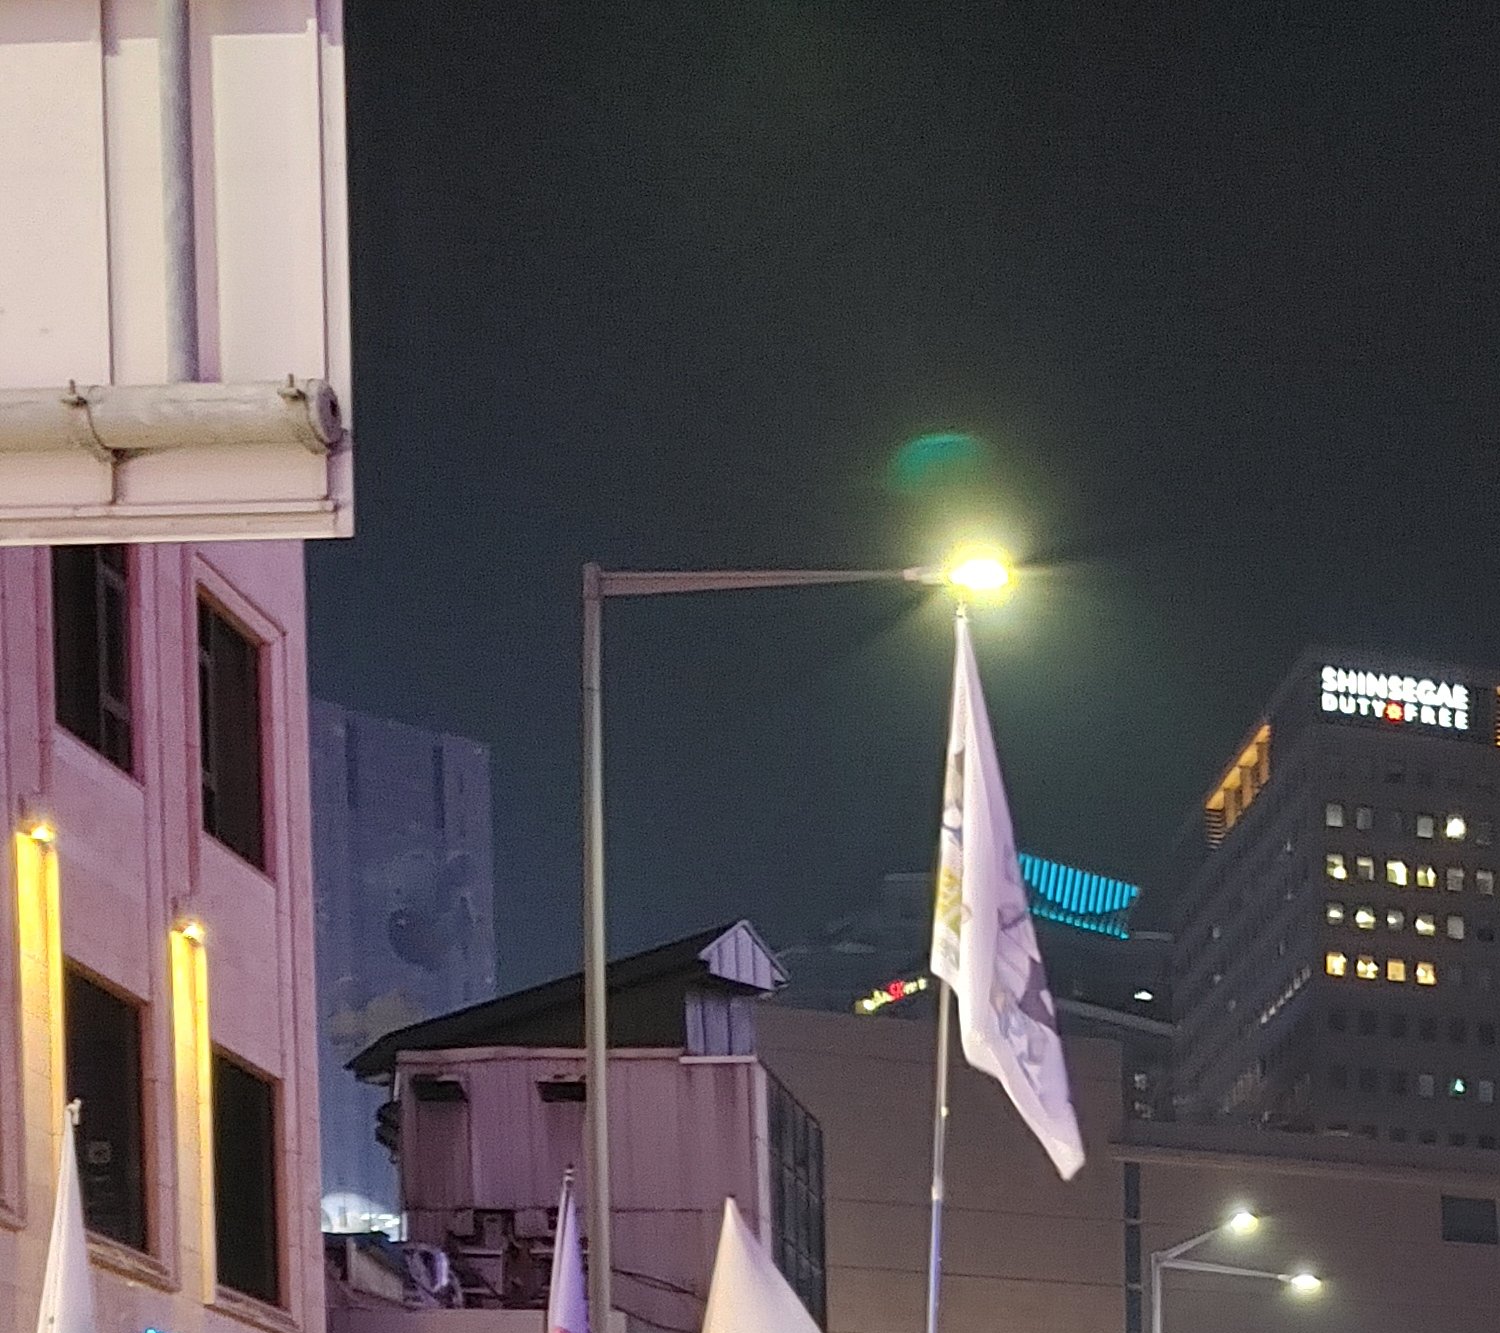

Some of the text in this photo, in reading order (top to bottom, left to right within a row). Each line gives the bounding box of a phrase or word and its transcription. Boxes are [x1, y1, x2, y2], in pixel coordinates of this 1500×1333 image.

[1321, 665, 1469, 710] SHINSEGAE
[1321, 691, 1469, 730] DUTY FREE
